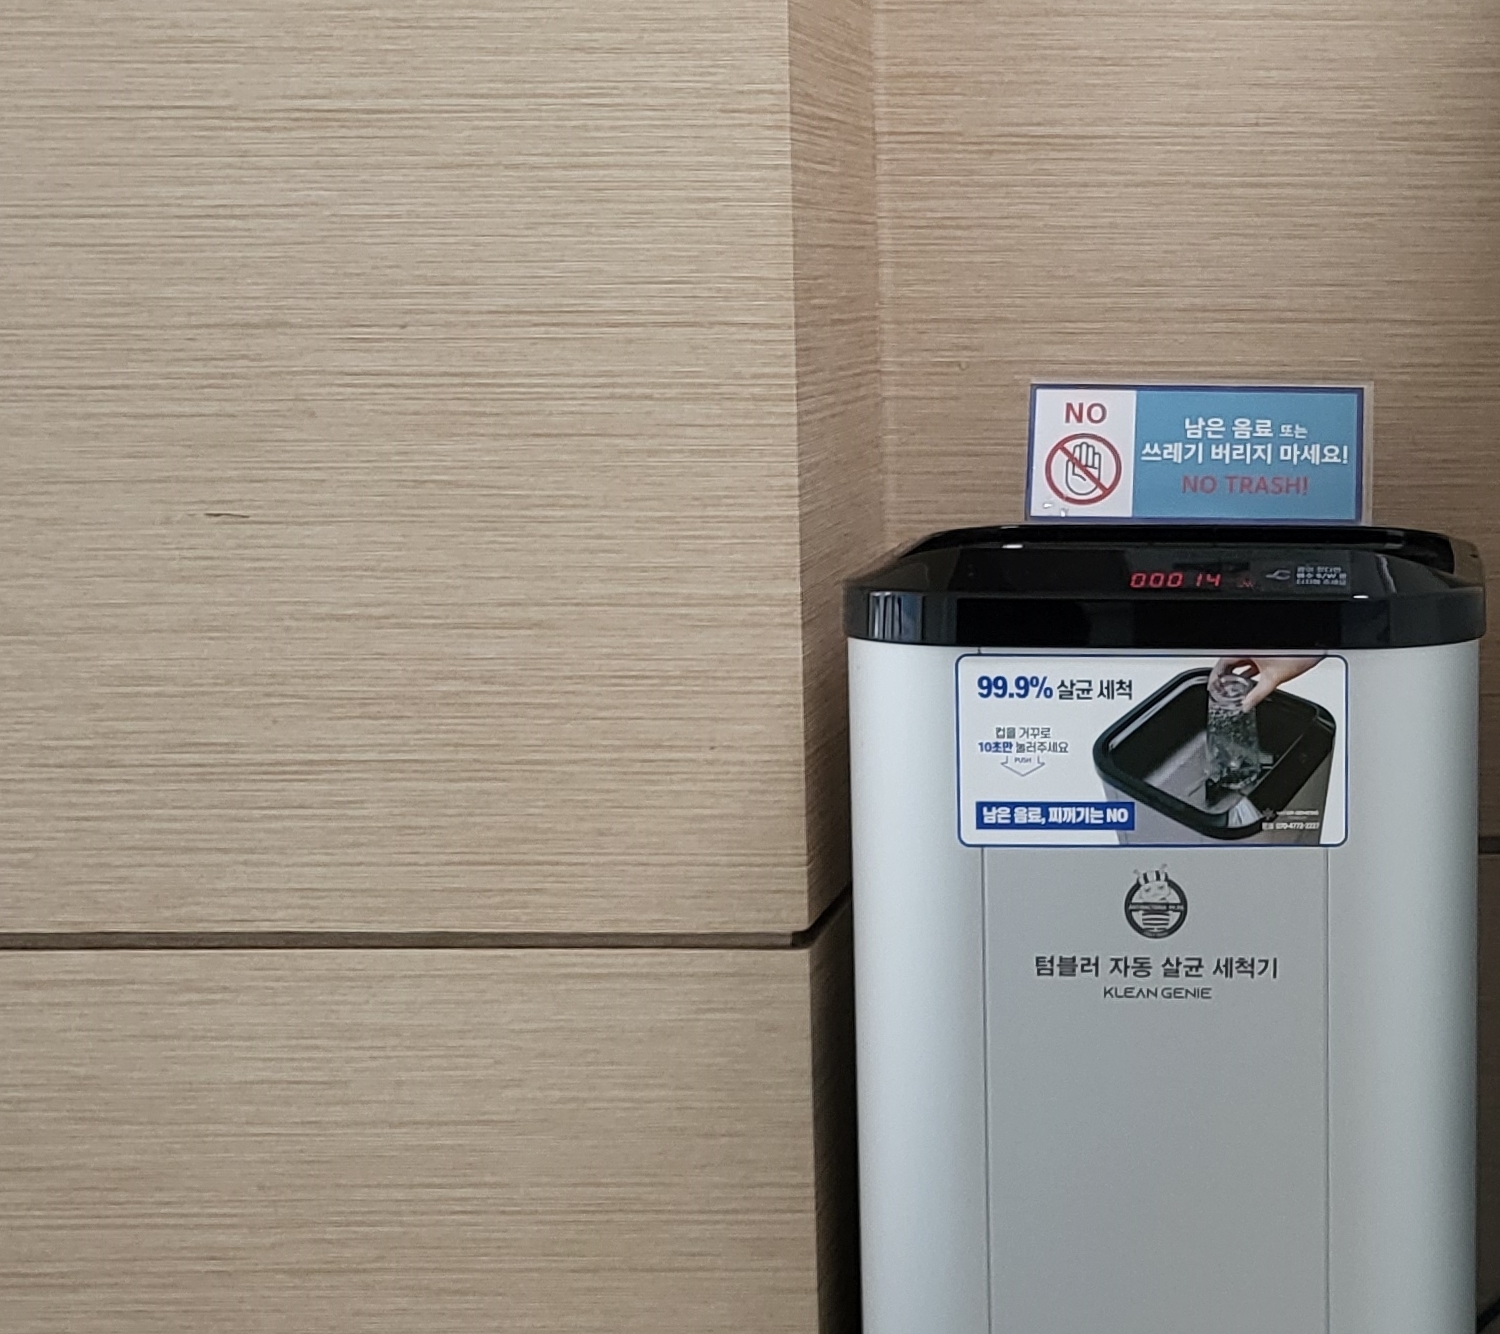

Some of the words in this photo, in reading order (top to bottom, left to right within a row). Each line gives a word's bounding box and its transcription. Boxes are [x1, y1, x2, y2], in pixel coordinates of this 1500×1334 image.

[1064, 402, 1108, 424] NO
[1184, 417, 1226, 440] 남은
[1232, 418, 1273, 439] 음료
[1279, 424, 1308, 439] 또는
[1140, 441, 1203, 464] 쓰레기
[1210, 443, 1272, 465] 버리지
[1279, 444, 1348, 466] 마세요!
[1182, 475, 1217, 495] NO
[1225, 475, 1309, 495] TRASH!
[978, 676, 1054, 699] 99.9%
[1056, 679, 1094, 700] 살균
[1097, 679, 1133, 700] 세척
[995, 727, 1016, 739] 컵을
[1019, 727, 1051, 739] 거꾸로
[978, 742, 1013, 753] 10초만
[1016, 742, 1069, 754] 눌러주세요
[983, 807, 1011, 824] 남은
[1014, 807, 1046, 825] 음료,
[1106, 808, 1129, 823] NO
[1035, 955, 1100, 978] 텀블러
[1109, 956, 1153, 978] 자동
[1161, 956, 1204, 978] 살균
[1212, 957, 1278, 979] 세척기
[1103, 986, 1158, 999] KLEAN
[1161, 986, 1212, 999] GENIE
